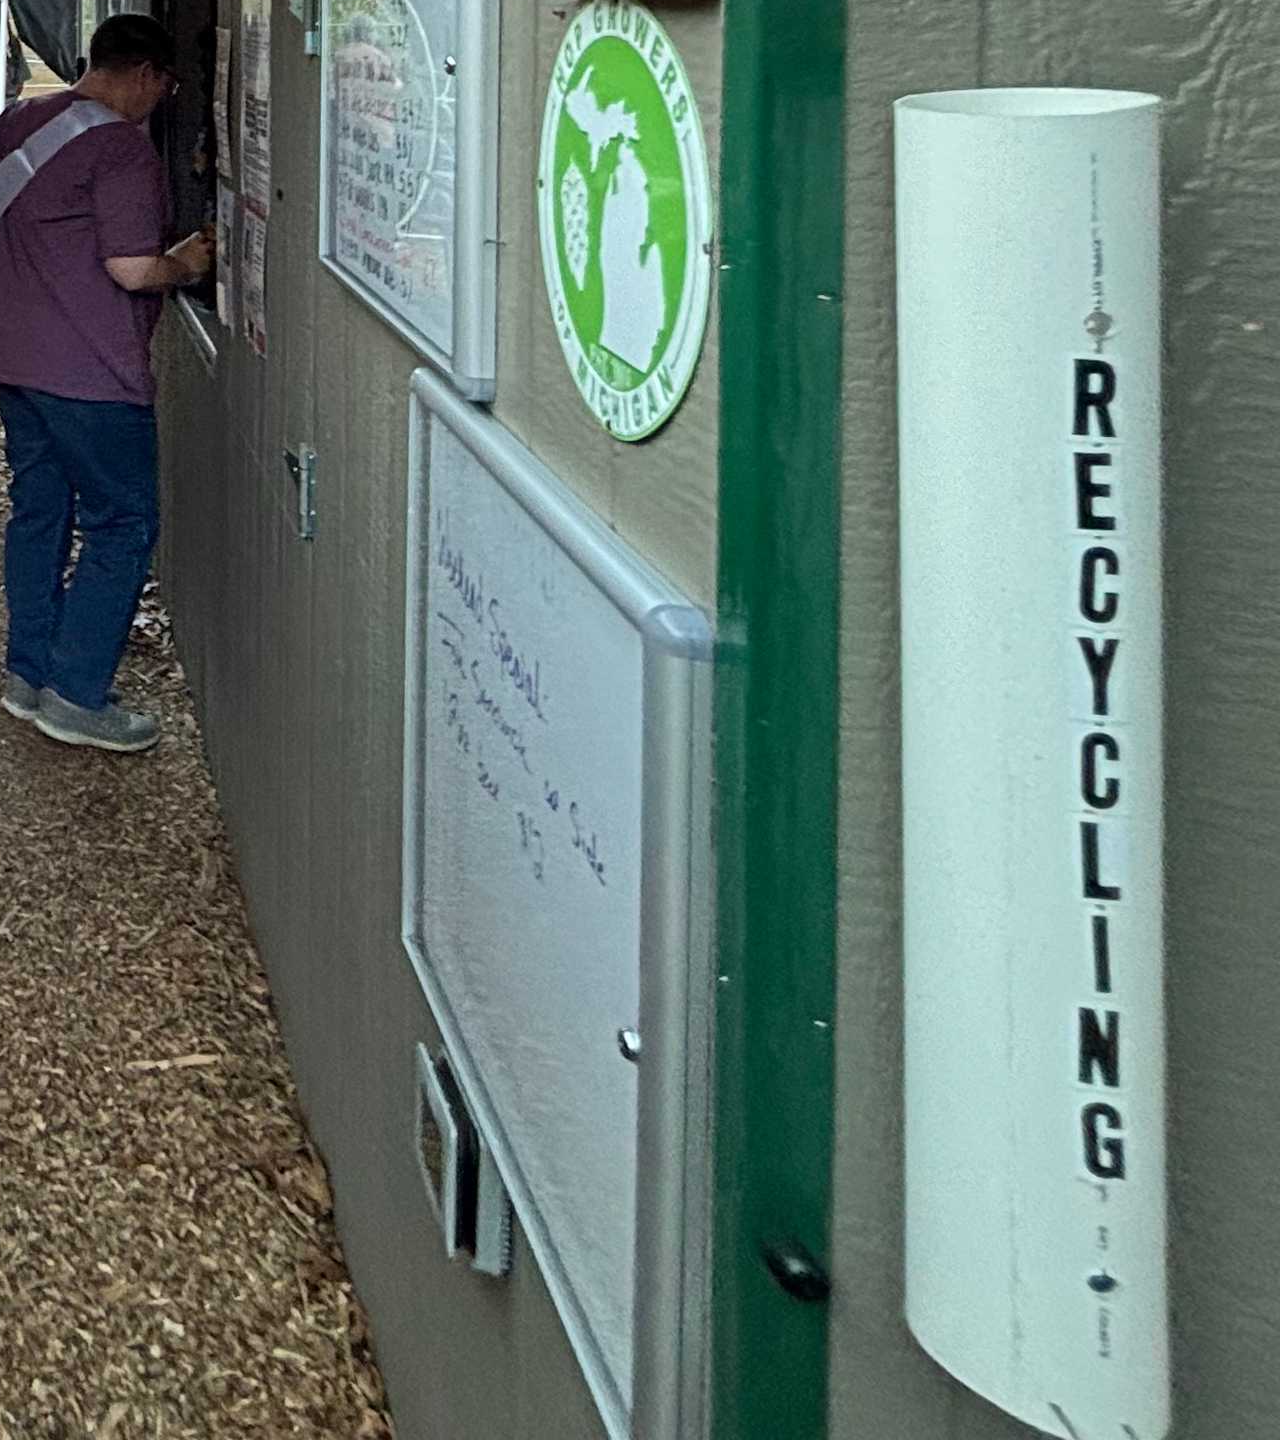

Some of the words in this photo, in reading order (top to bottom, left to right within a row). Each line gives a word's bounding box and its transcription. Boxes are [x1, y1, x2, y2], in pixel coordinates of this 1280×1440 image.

[555, 23, 582, 95] HOP
[593, 0, 689, 123] GROWERS
[576, 355, 675, 429] MICHIGAN
[1072, 358, 1125, 1180] RECYCLING
